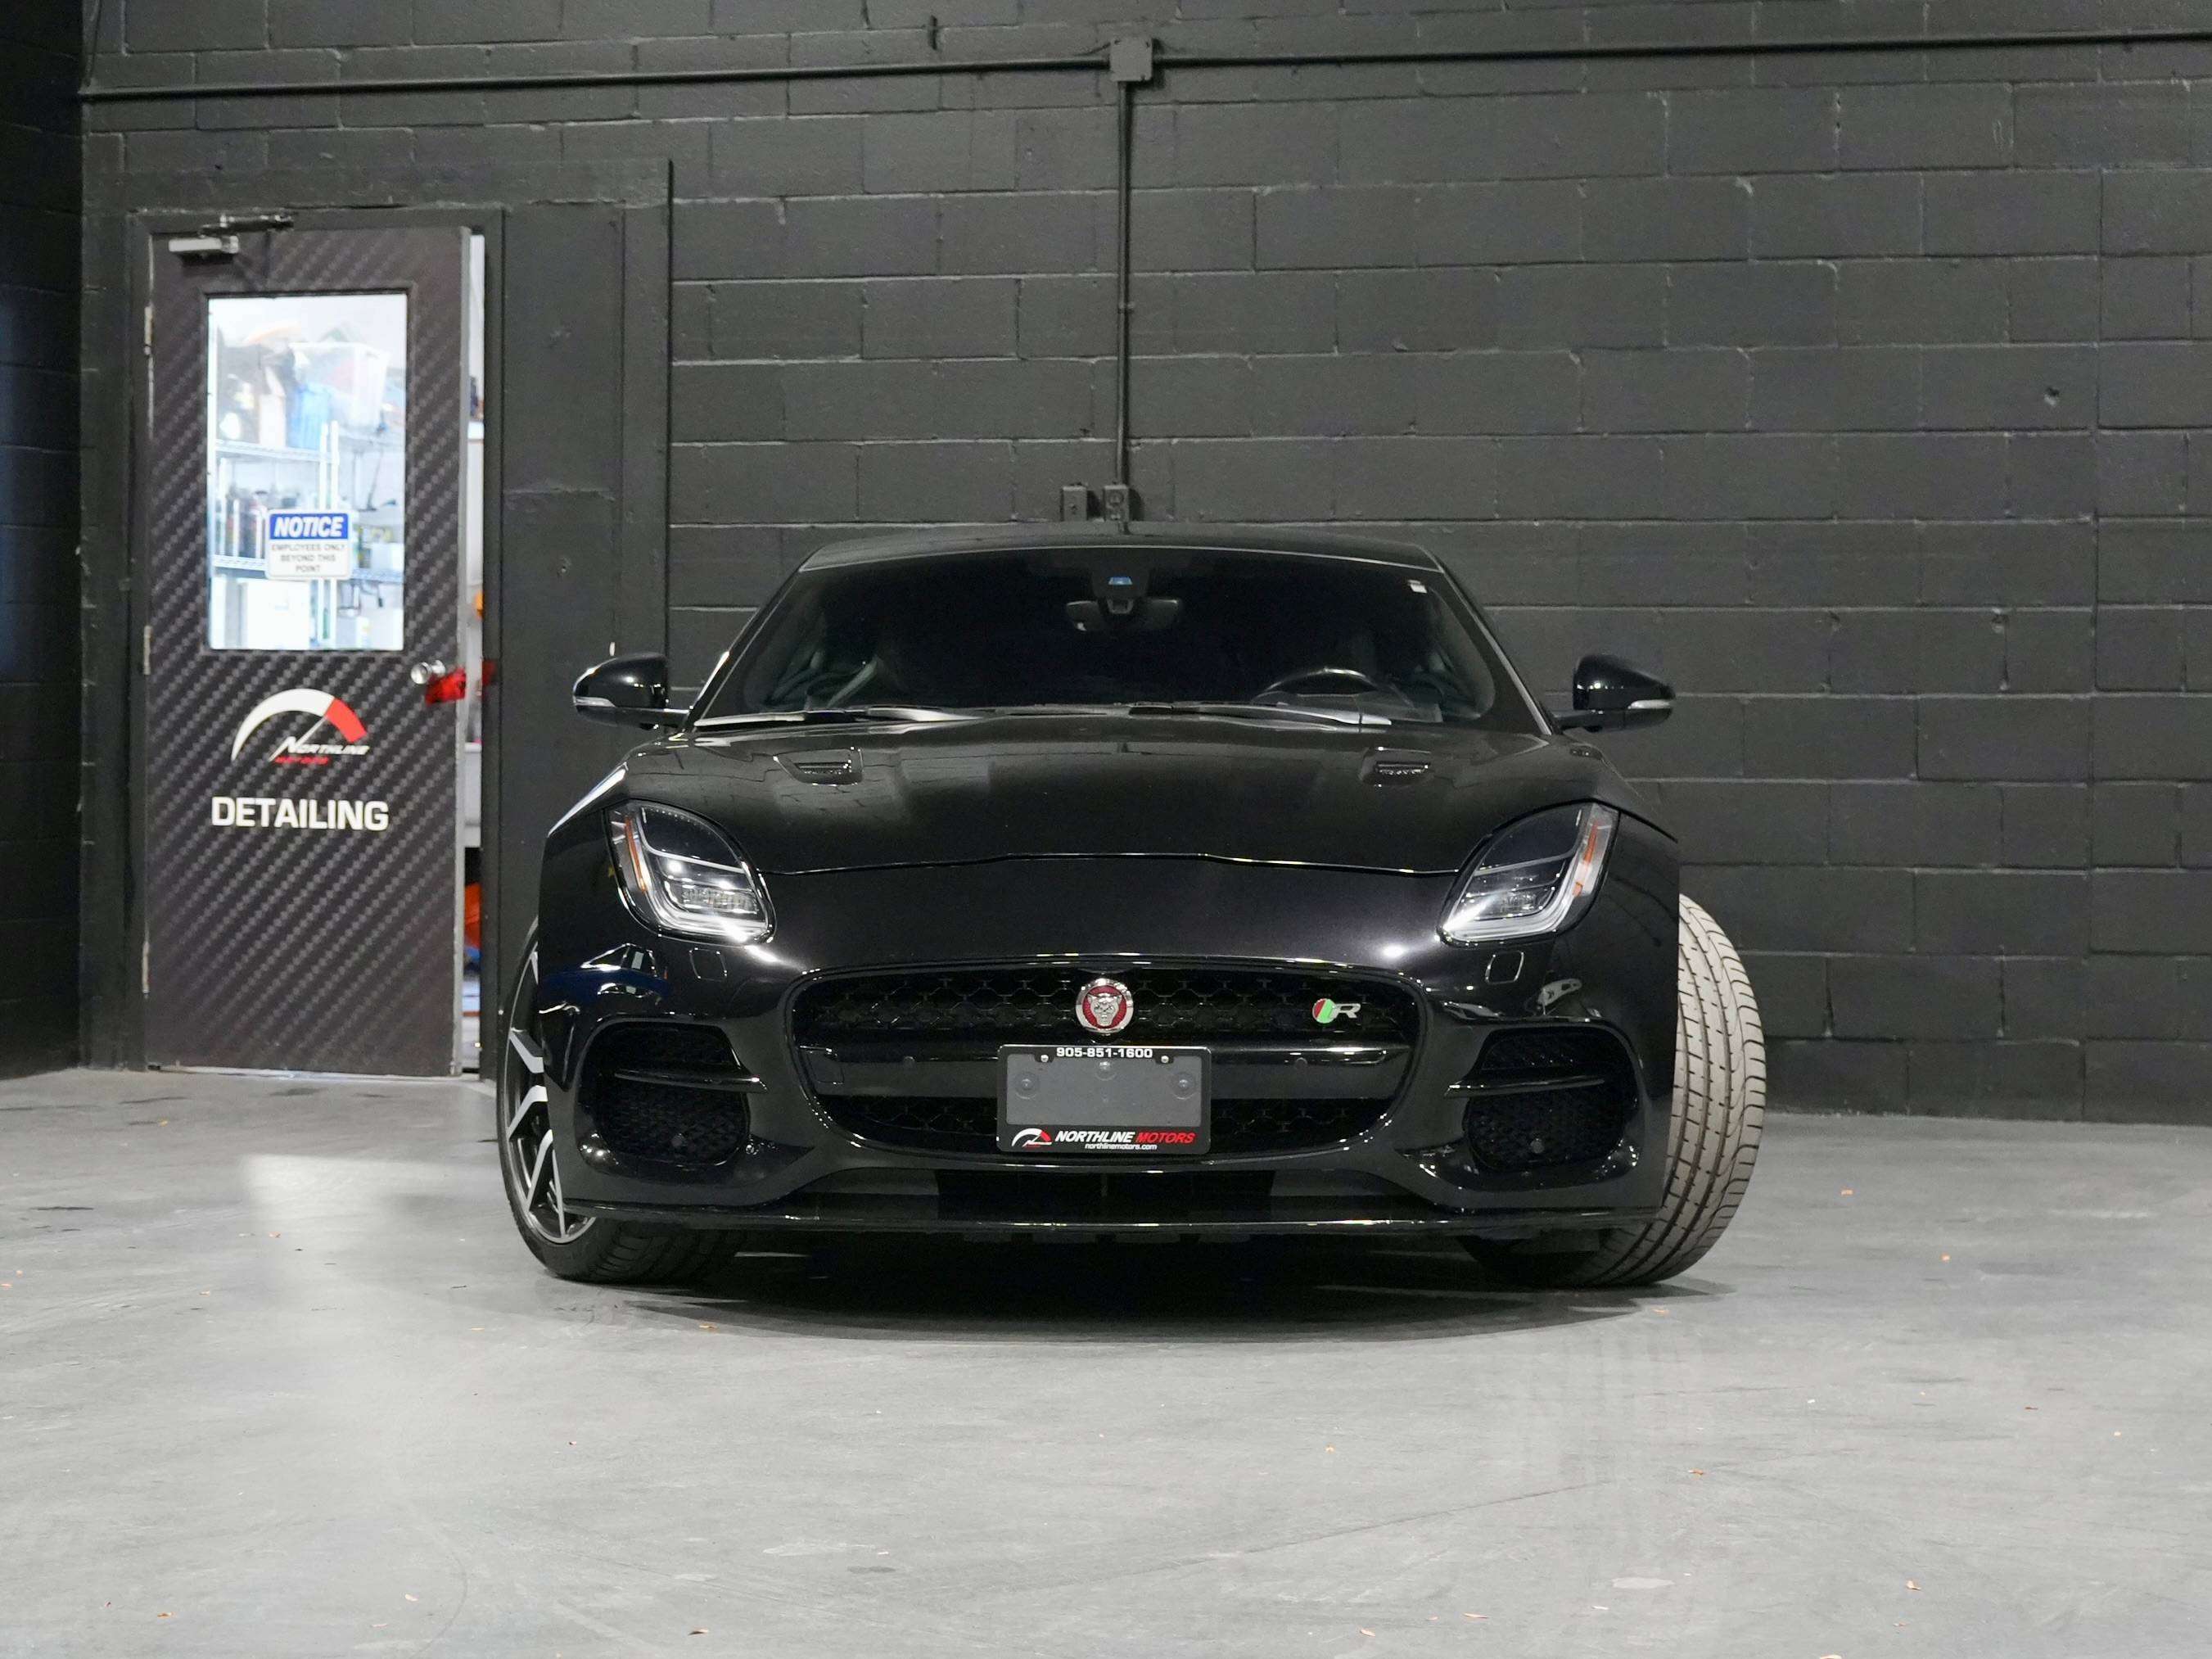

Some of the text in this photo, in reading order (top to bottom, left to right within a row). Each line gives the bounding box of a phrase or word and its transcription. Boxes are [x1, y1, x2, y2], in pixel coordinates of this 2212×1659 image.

[274, 516, 344, 537] NOTICE
[211, 796, 390, 831] DETAILING
[1056, 1047, 1153, 1058] 905-851-1600
[1054, 1131, 1195, 1143] NORTHLINE MOTORS
